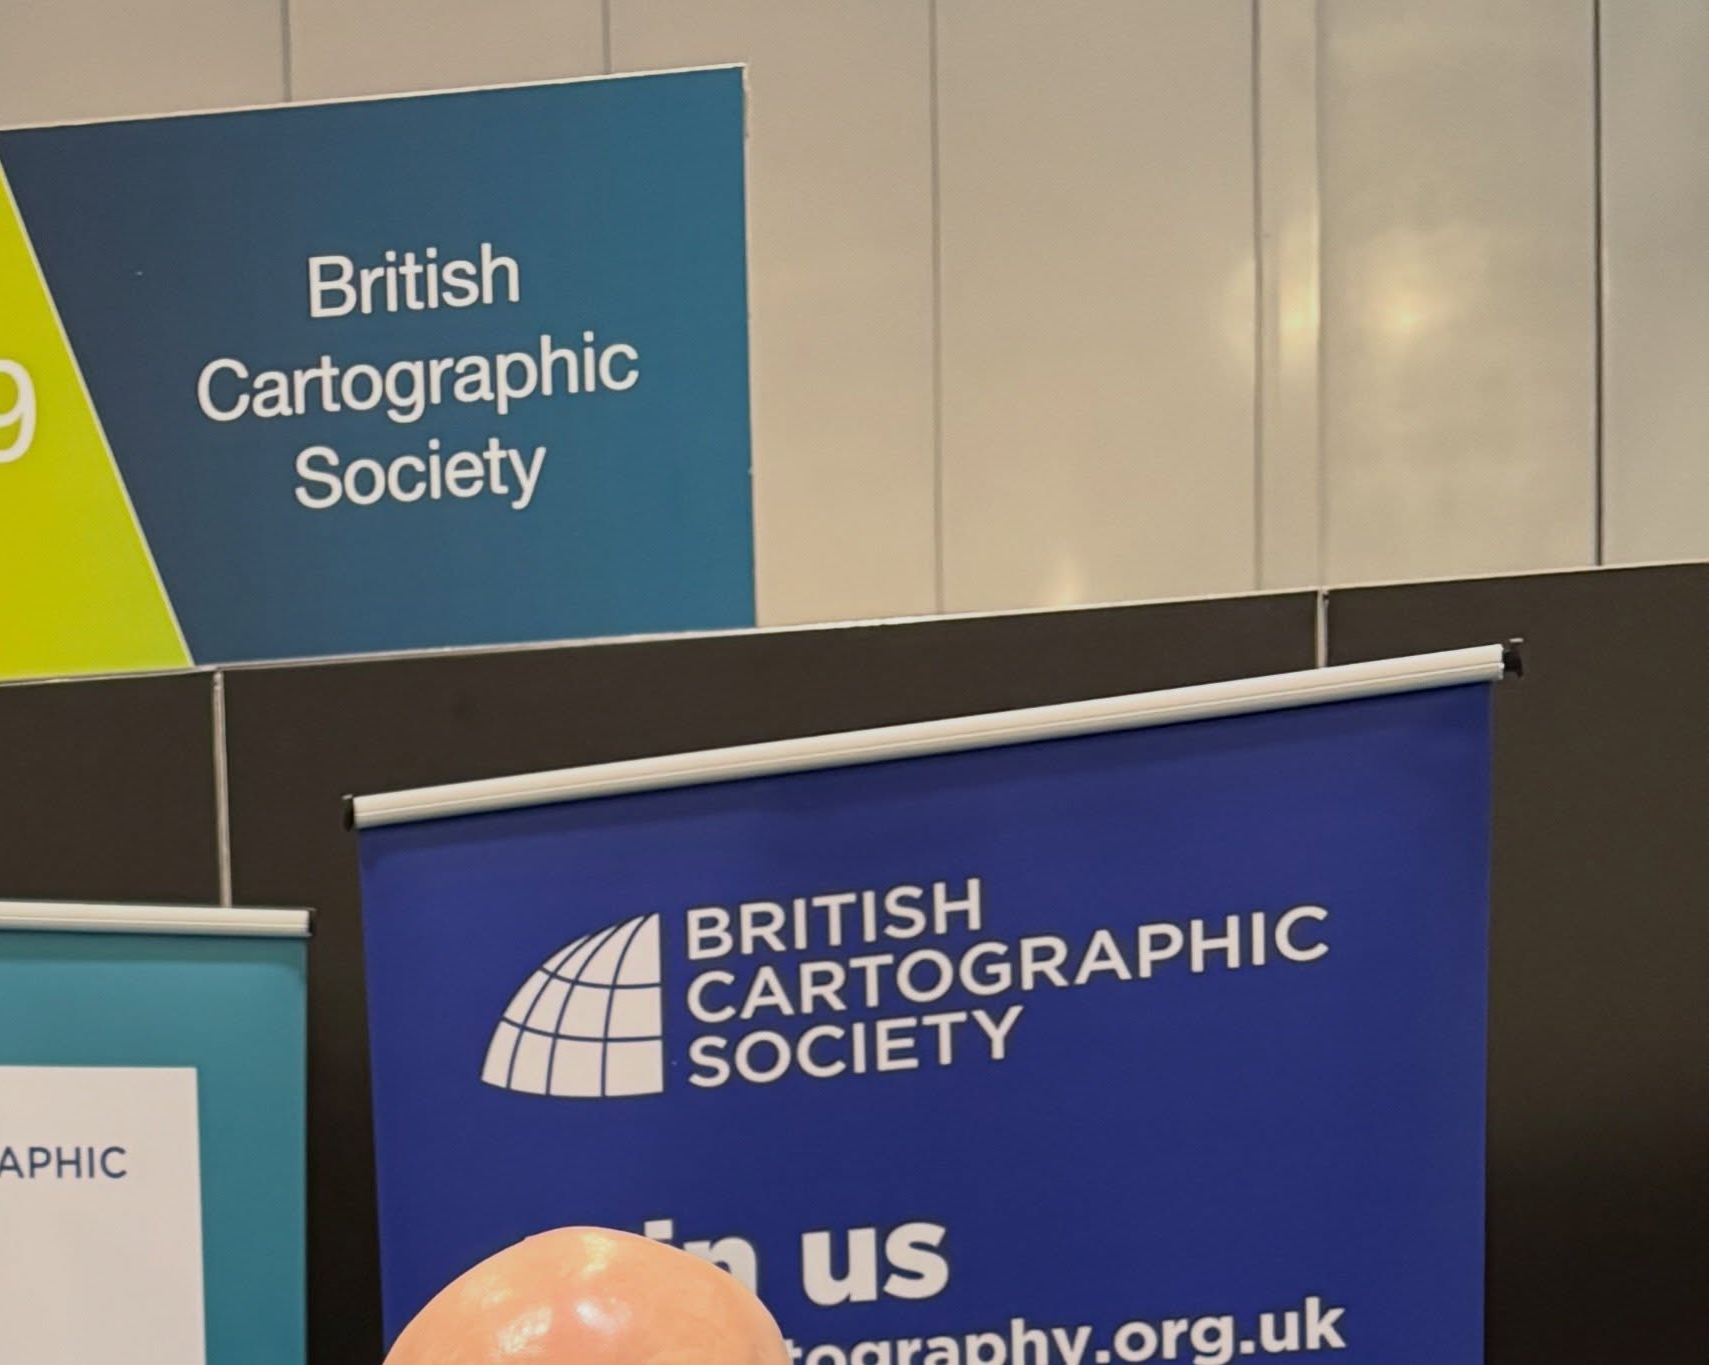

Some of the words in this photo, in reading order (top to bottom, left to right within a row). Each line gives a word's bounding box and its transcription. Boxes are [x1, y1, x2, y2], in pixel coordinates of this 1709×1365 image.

[306, 241, 521, 319] British
[196, 330, 640, 424] Cartographic
[293, 437, 547, 509] Society
[688, 878, 983, 960] BRITISH
[687, 905, 1331, 1024] CARTOGRAPHIC
[687, 1005, 1025, 1089] SOCIETY
[801, 1218, 951, 1307] us
